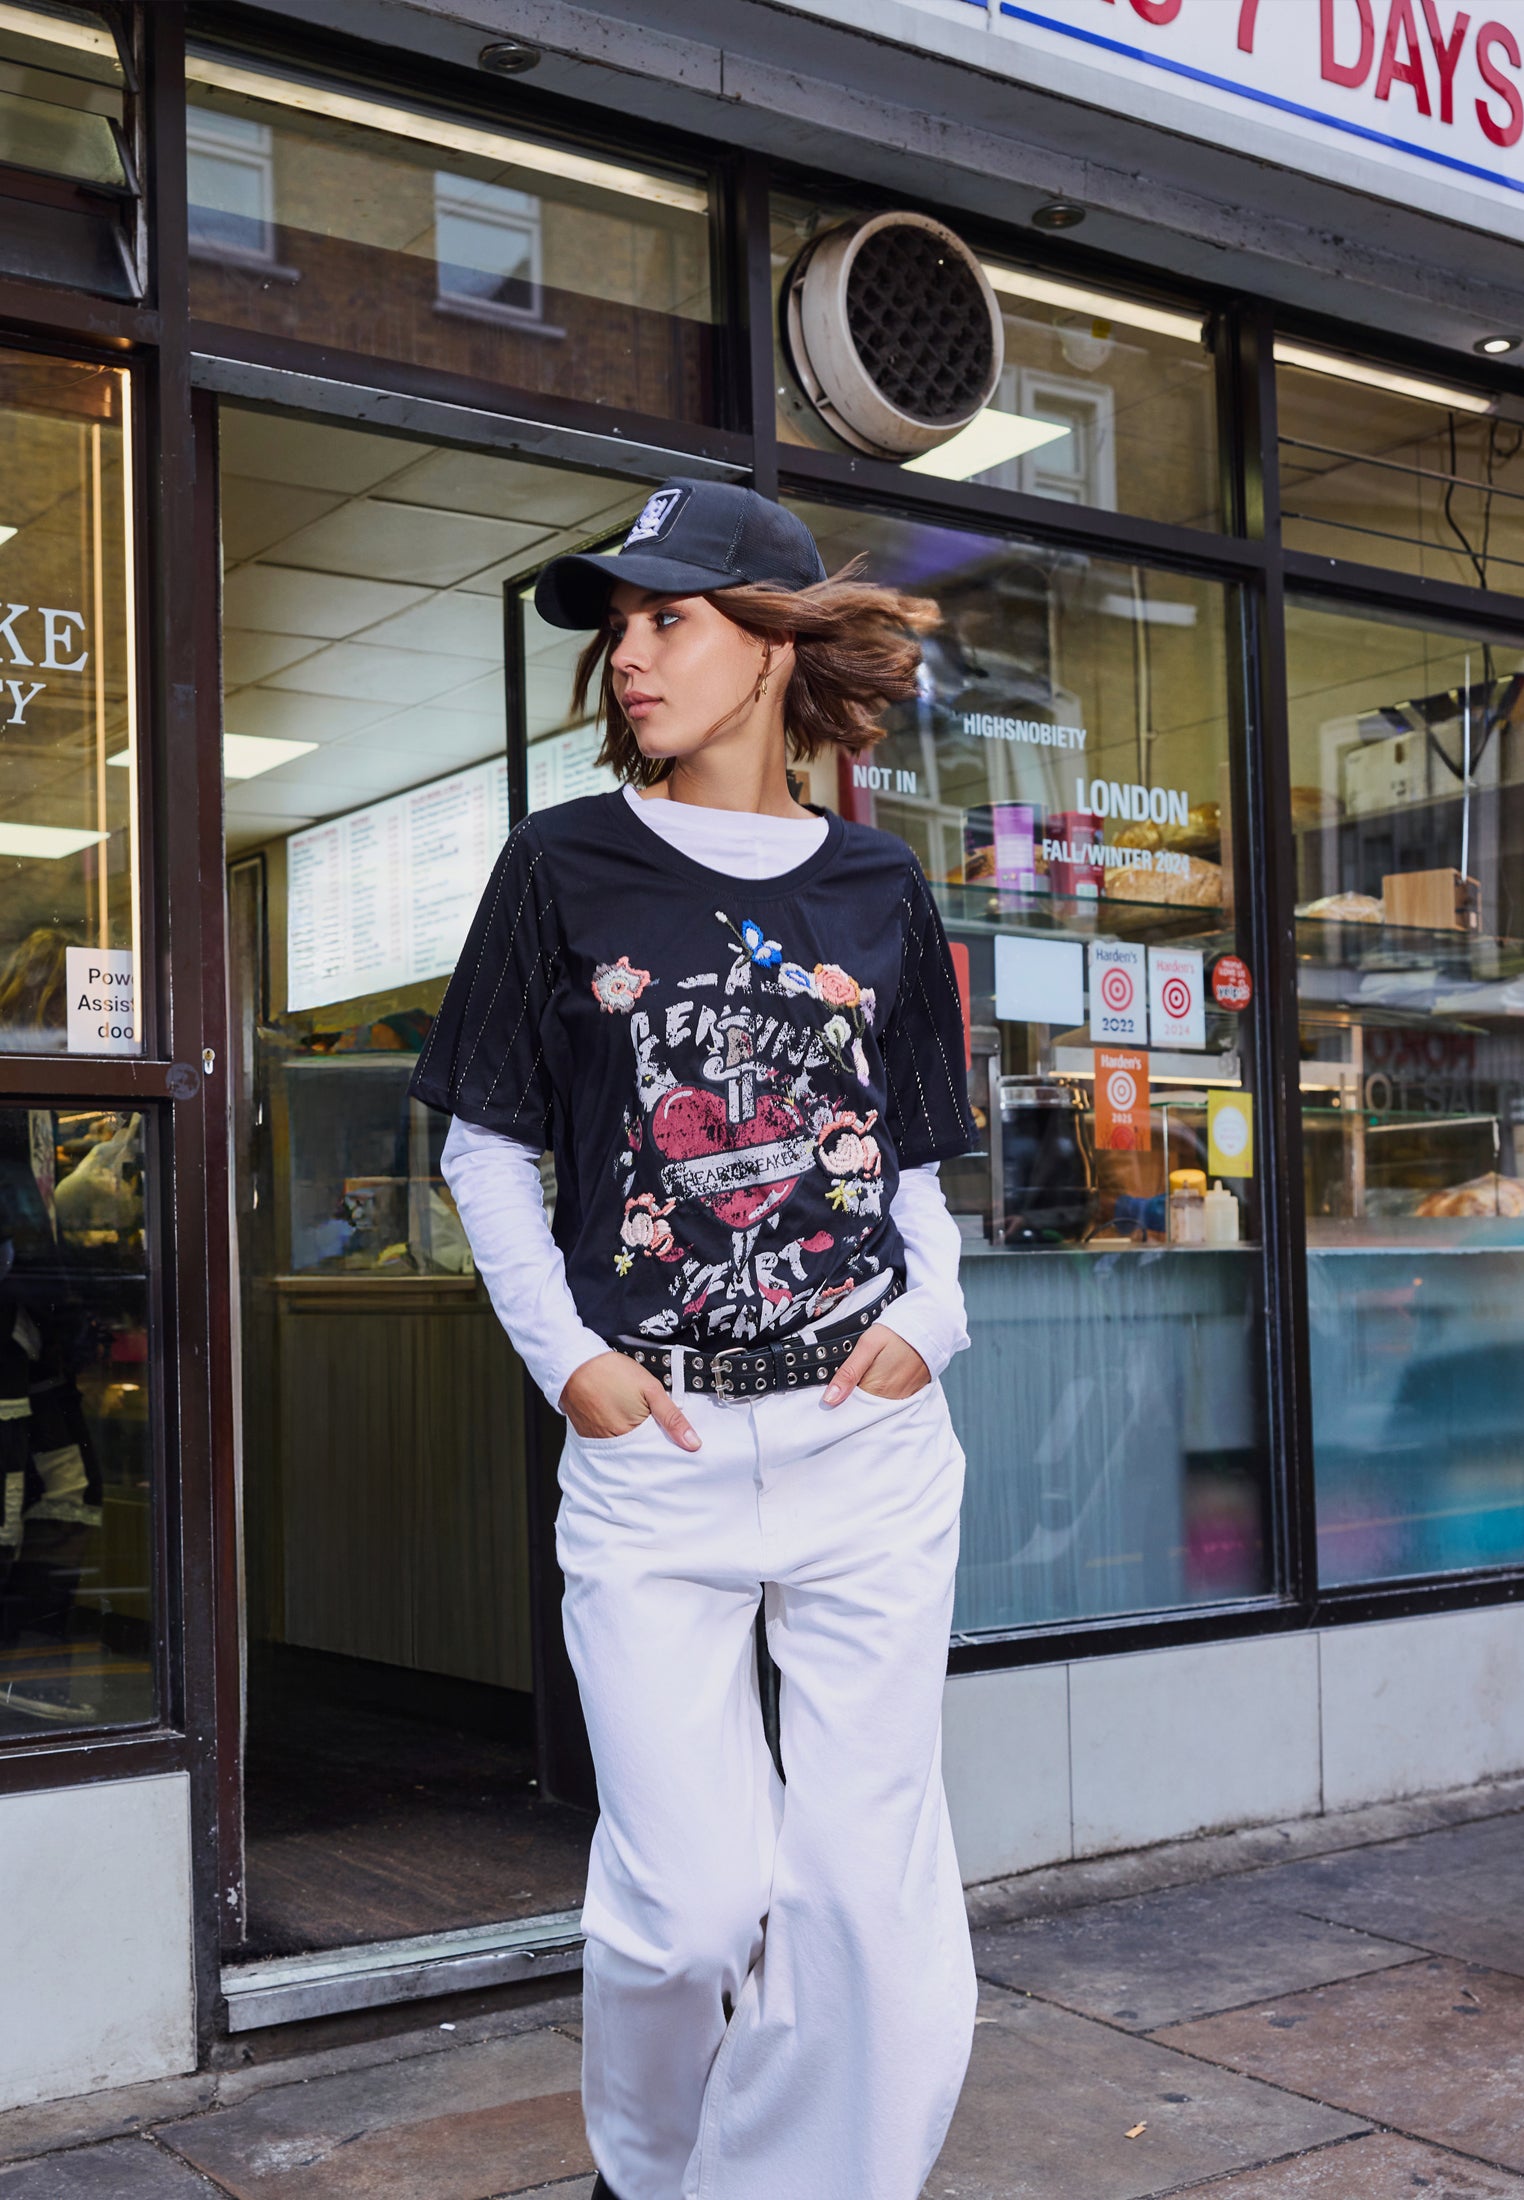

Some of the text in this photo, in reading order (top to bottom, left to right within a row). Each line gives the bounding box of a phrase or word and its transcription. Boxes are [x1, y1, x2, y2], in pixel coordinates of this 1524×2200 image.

[1320, 0, 1524, 147] DAYS
[0, 679, 47, 725] Y
[963, 713, 1087, 750] HIGHSNOBIETY
[853, 764, 917, 794] NOT IN
[1076, 778, 1189, 826] LONDON
[1042, 838, 1191, 881] FALL/WINTER 2024
[1096, 948, 1138, 964] Harden's
[1156, 960, 1196, 974] Harden's
[88, 967, 134, 986] Pow
[1102, 1017, 1135, 1033] 2022
[1101, 1055, 1142, 1070] Harden's
